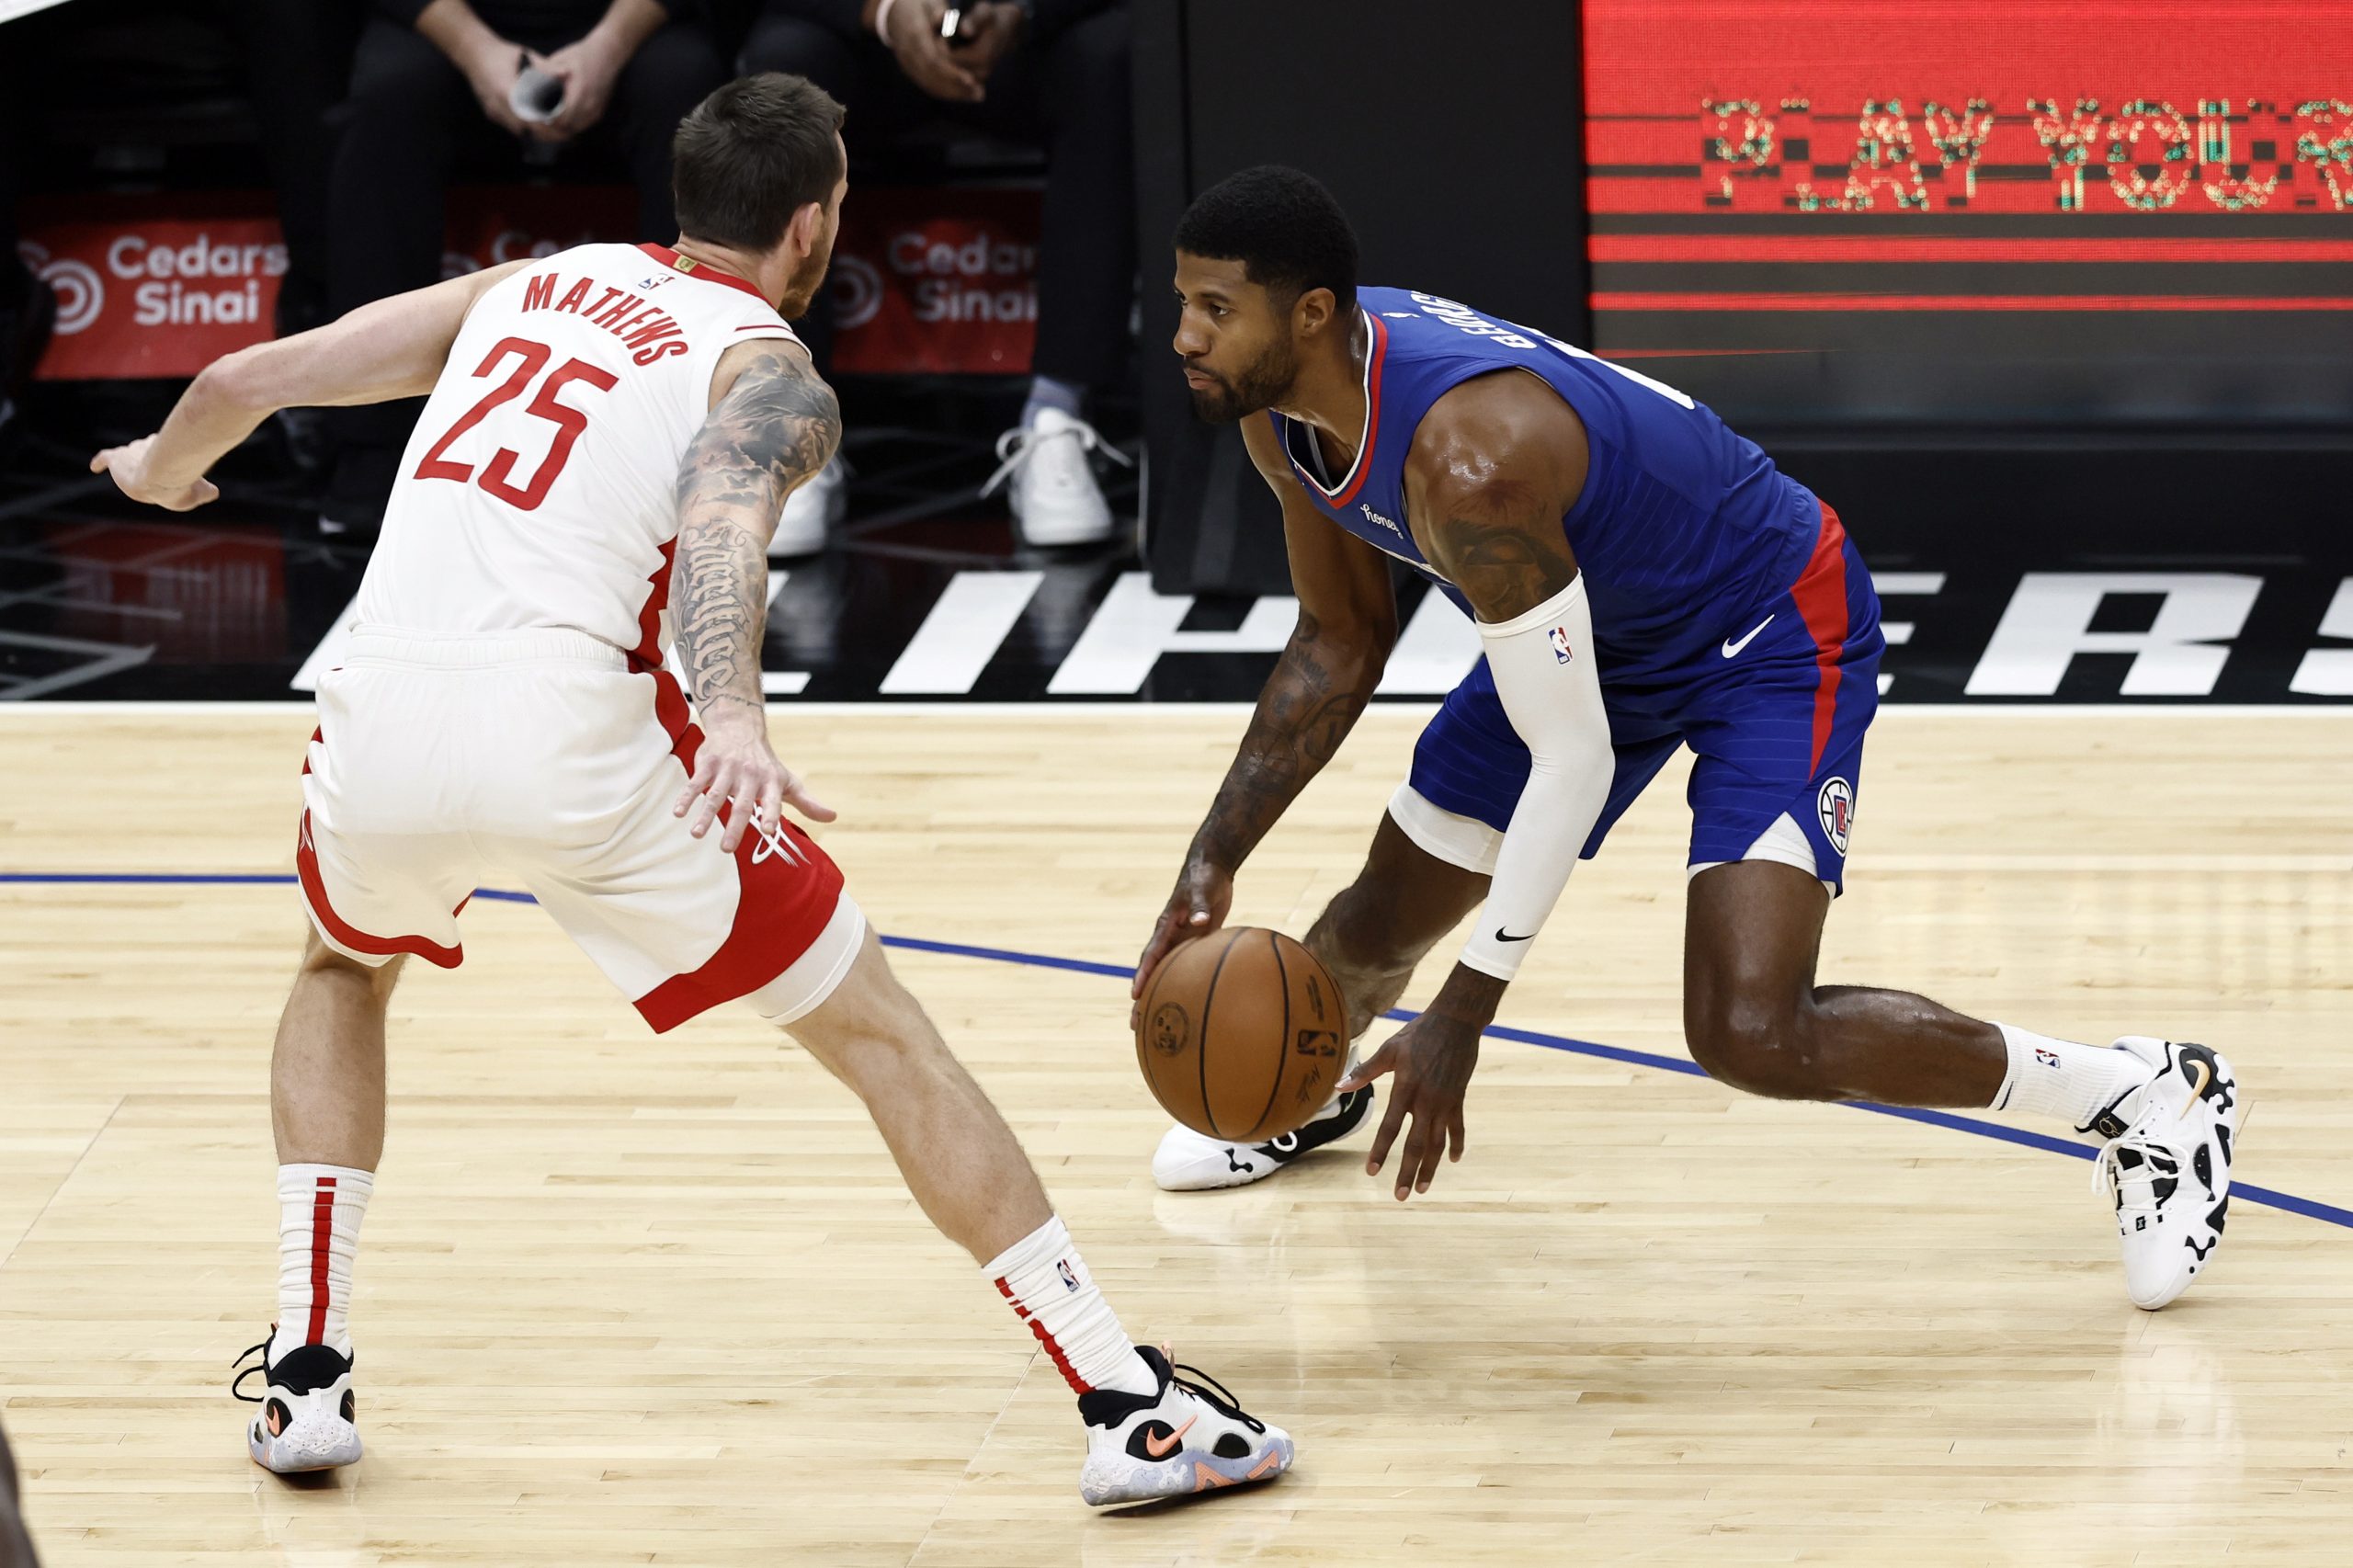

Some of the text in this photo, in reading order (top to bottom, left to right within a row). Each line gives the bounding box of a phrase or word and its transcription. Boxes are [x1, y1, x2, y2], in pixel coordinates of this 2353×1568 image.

[1702, 97, 1995, 211] PLAY
[106, 233, 290, 279] Cedars
[888, 233, 1037, 275] Cedar
[132, 279, 261, 326] Sinai
[521, 272, 688, 367] MATHEWS
[915, 278, 1039, 322] Sinai
[1410, 290, 1538, 350] GEORG
[413, 336, 620, 511] 25
